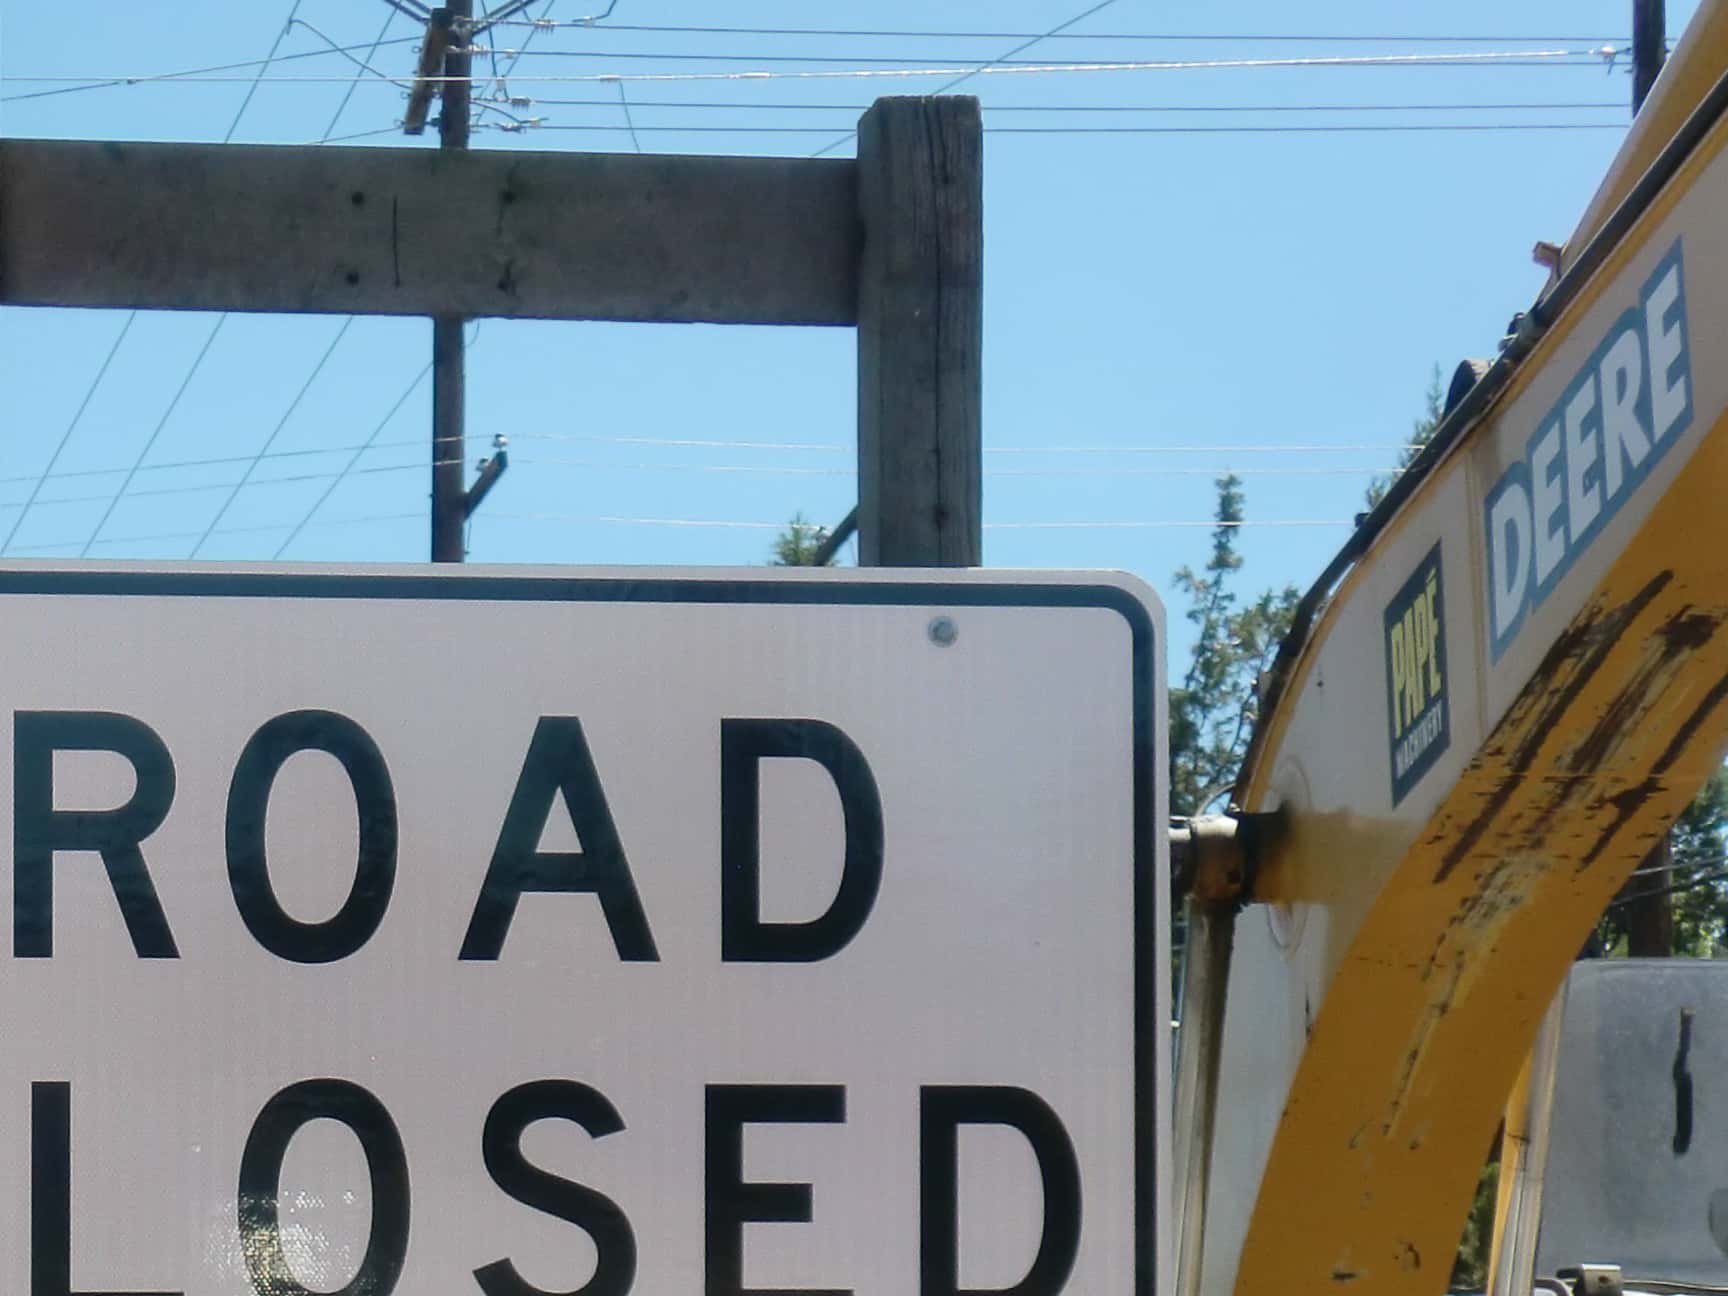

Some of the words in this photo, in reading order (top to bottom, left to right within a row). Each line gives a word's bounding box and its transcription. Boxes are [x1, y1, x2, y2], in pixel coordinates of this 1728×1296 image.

[1490, 263, 1687, 642] DEERE
[1390, 566, 1443, 741] PAPÉ
[1395, 699, 1444, 781] MACHINERY
[14, 710, 884, 964] ROAD
